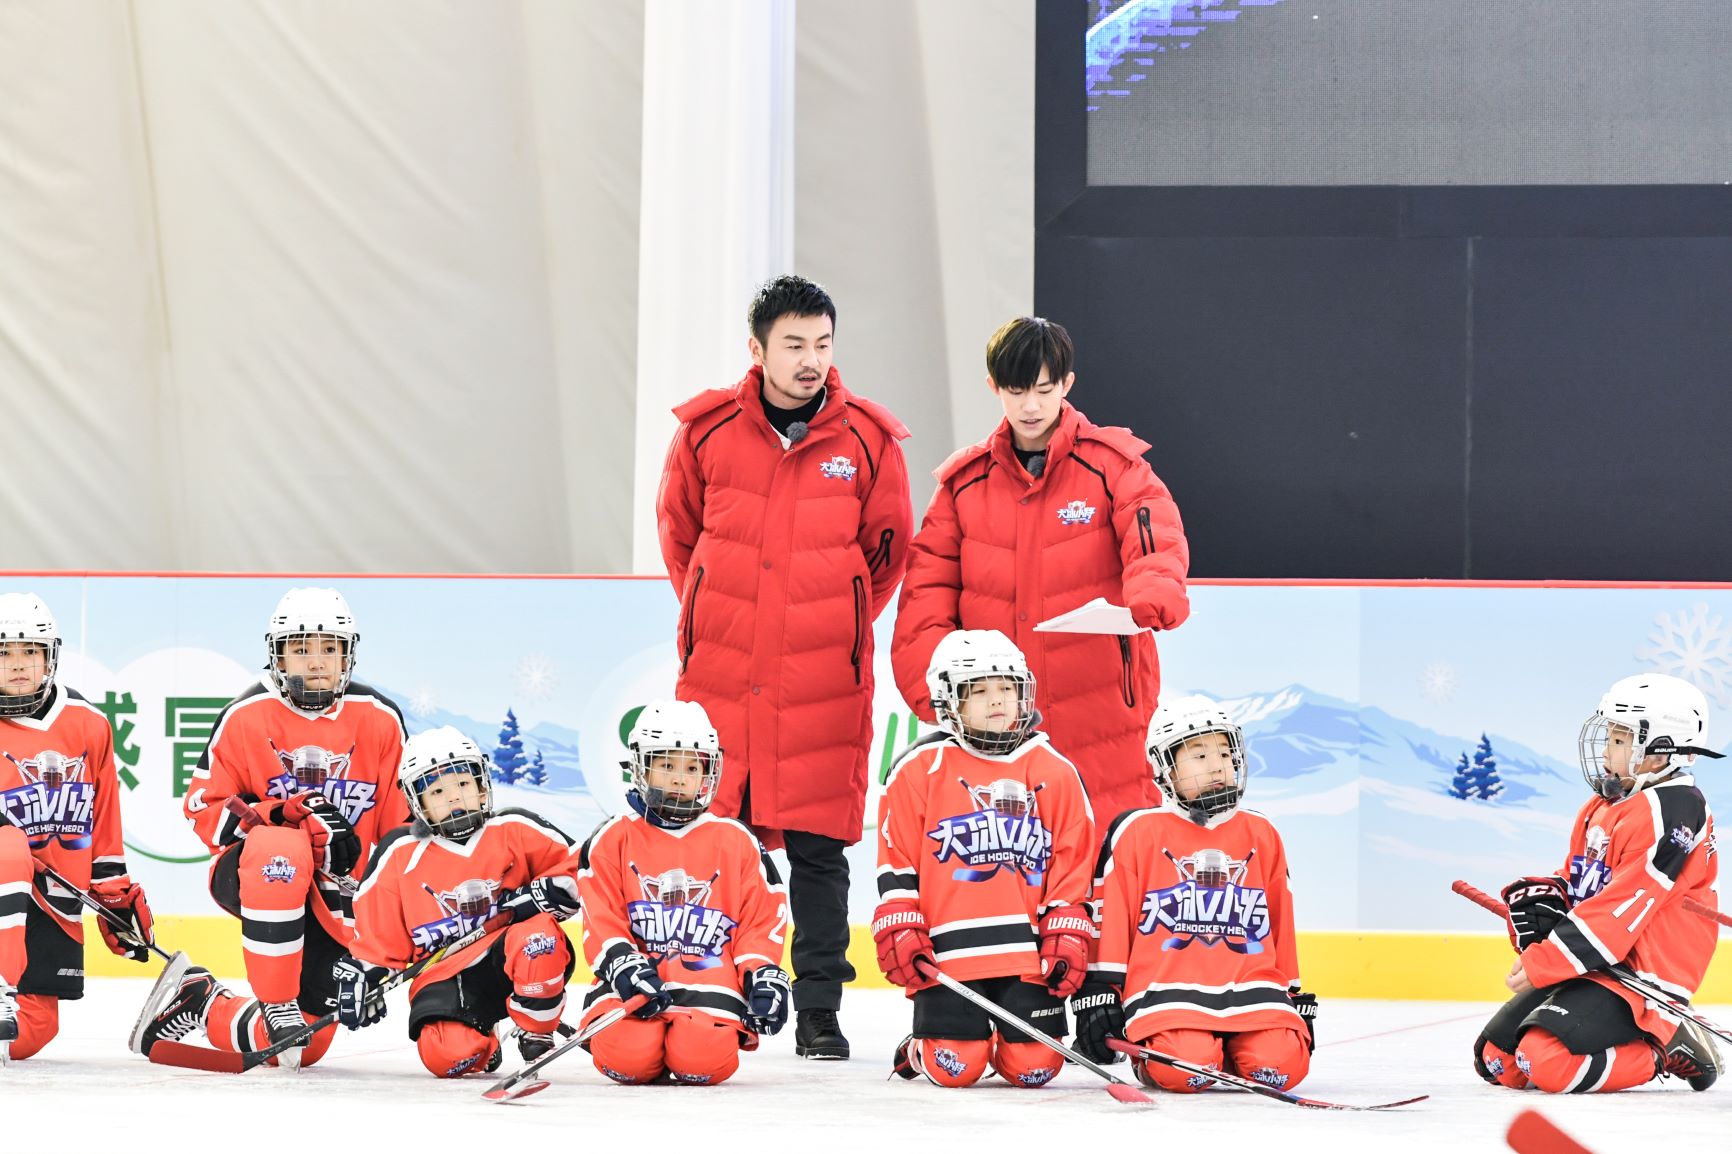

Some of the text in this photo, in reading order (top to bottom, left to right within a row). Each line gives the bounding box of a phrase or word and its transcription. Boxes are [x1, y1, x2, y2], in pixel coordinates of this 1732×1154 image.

[1138, 884, 1270, 940] 大冰小将
[1611, 888, 1656, 934] 11
